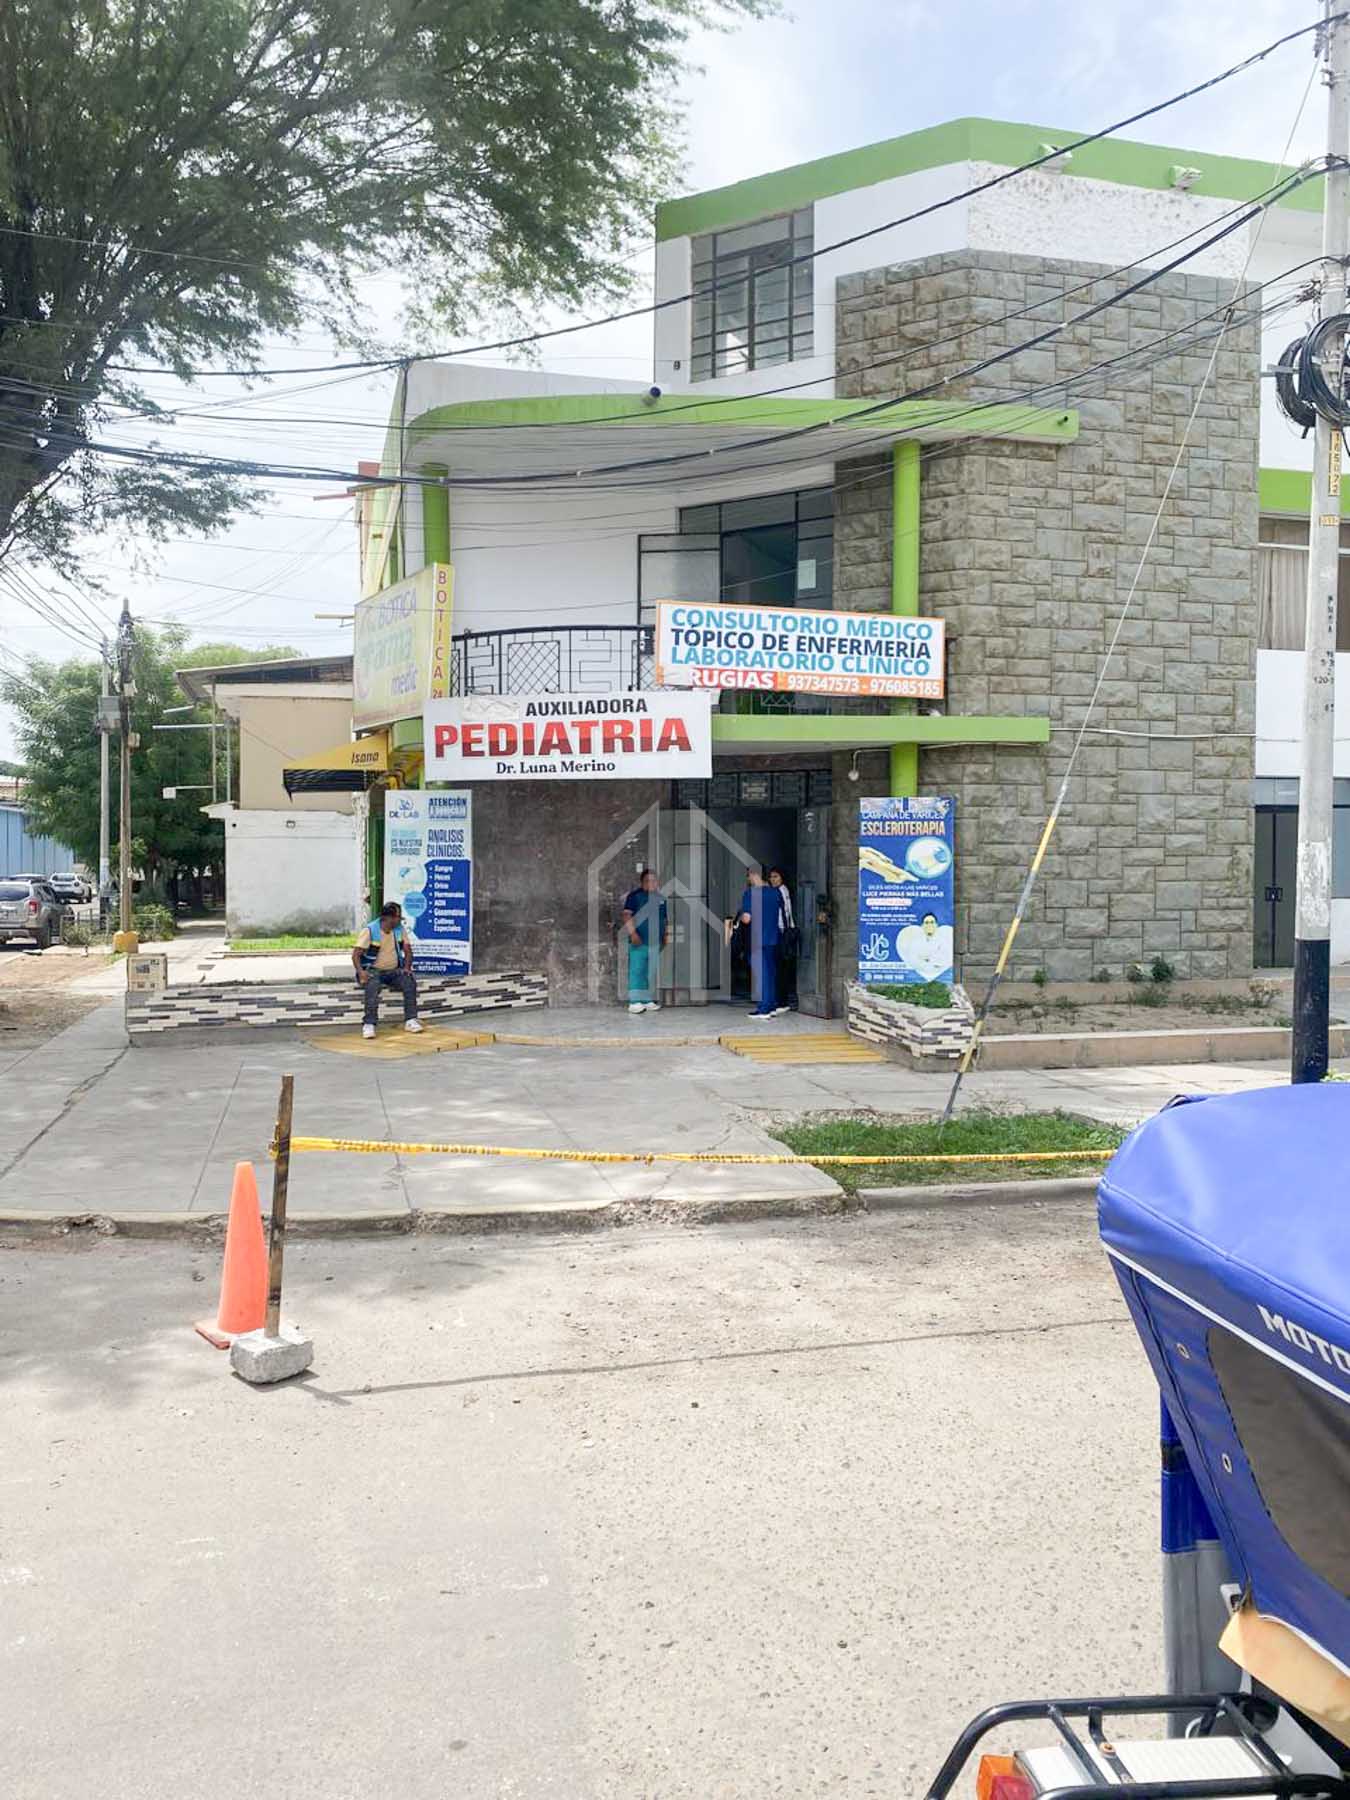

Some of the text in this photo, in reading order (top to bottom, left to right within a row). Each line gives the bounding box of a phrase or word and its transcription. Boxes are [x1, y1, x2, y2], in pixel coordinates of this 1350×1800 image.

[434, 571, 447, 680] BOTICA
[671, 607, 933, 640] CONSULTORIO MÉDICO
[671, 623, 931, 659] TÓPICO DE ENFERMERÍA
[671, 646, 930, 677] LABORATORIO CLÍNICO
[787, 675, 860, 693] 937347573
[869, 678, 940, 696] 976085185
[525, 698, 648, 717] AUXILIADORA
[434, 718, 693, 759] PEDIATRIA
[496, 760, 616, 775] Dr. Luna Merino
[861, 820, 946, 836] ESCLEROTERAPIA
